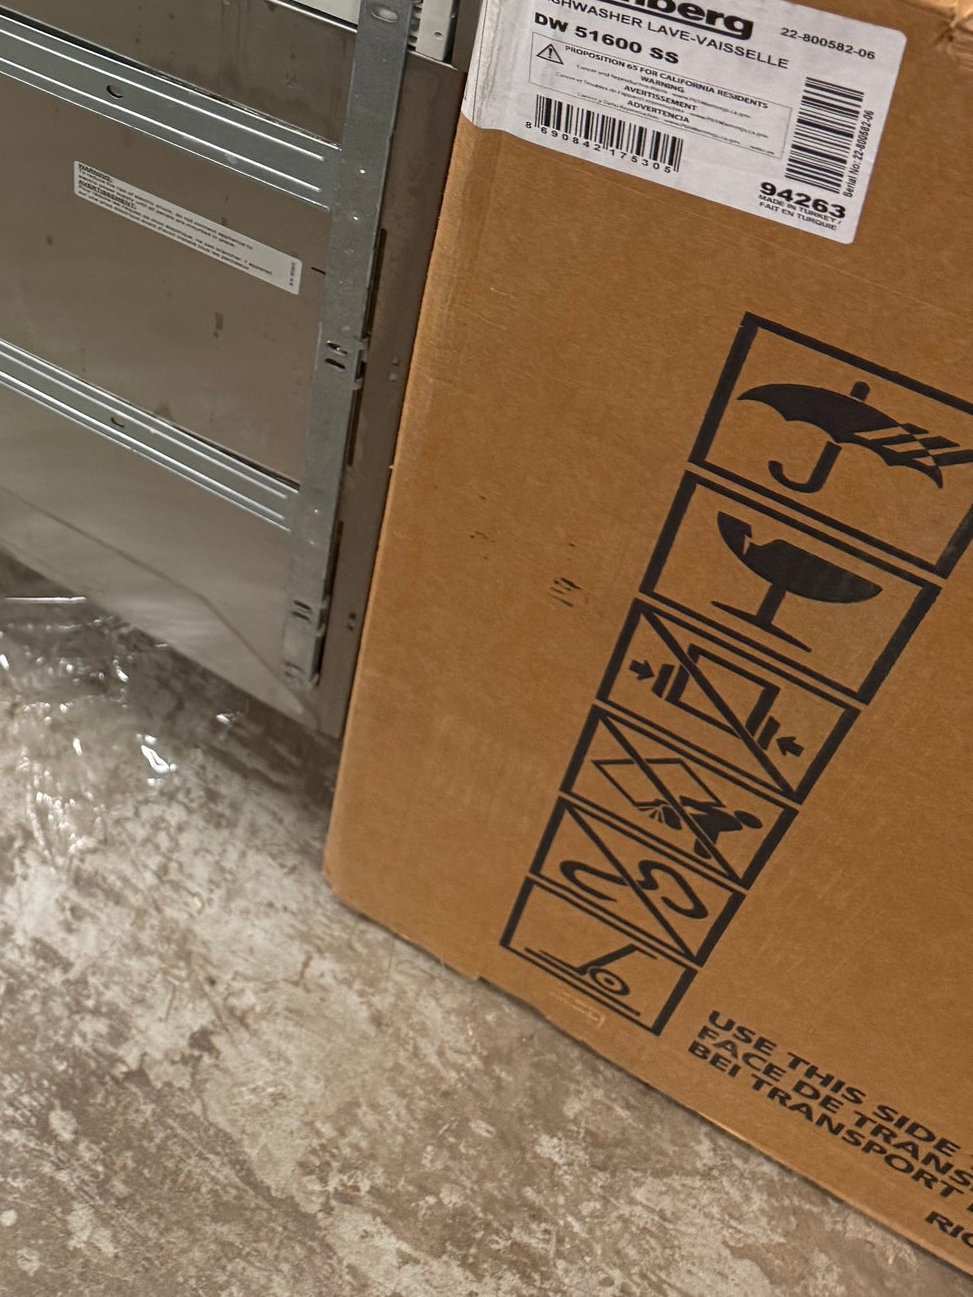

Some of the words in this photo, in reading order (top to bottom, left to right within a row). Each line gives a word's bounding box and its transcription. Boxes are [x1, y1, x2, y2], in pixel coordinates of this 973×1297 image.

[534, 11, 569, 33] DW
[574, 26, 643, 54] 51600
[649, 47, 680, 65] SS
[647, 21, 790, 70] LAVE-VAISSELLE
[780, 26, 876, 61] 22-800582-06
[565, 45, 625, 68] PROPOSITION
[626, 61, 638, 71] 65
[639, 66, 658, 77] FOR
[659, 72, 716, 94] CALIFORNIA
[717, 89, 769, 109] RESIDENTS
[624, 85, 698, 111] AVERTISSEMENT
[640, 75, 685, 94] WARNING
[626, 100, 690, 123] ADVERTENCIA
[843, 177, 858, 198] Serial
[853, 109, 875, 161] 22-800582-06
[758, 194, 785, 208] MADE
[786, 203, 797, 211] IN
[799, 207, 837, 223] TURKEY
[759, 181, 846, 219] 94263
[759, 202, 779, 213] FAIT
[781, 208, 795, 217] EN
[797, 214, 838, 231] TURQUIE
[708, 1010, 778, 1057] USE
[786, 1052, 866, 1105] THIS
[872, 1104, 961, 1158] SIDE
[687, 1040, 741, 1078] BEI
[750, 1073, 965, 1198] TRANSPORT
[697, 1025, 787, 1083] FACE
[792, 1079, 844, 1114] DE
[853, 1110, 973, 1192] TRANS
